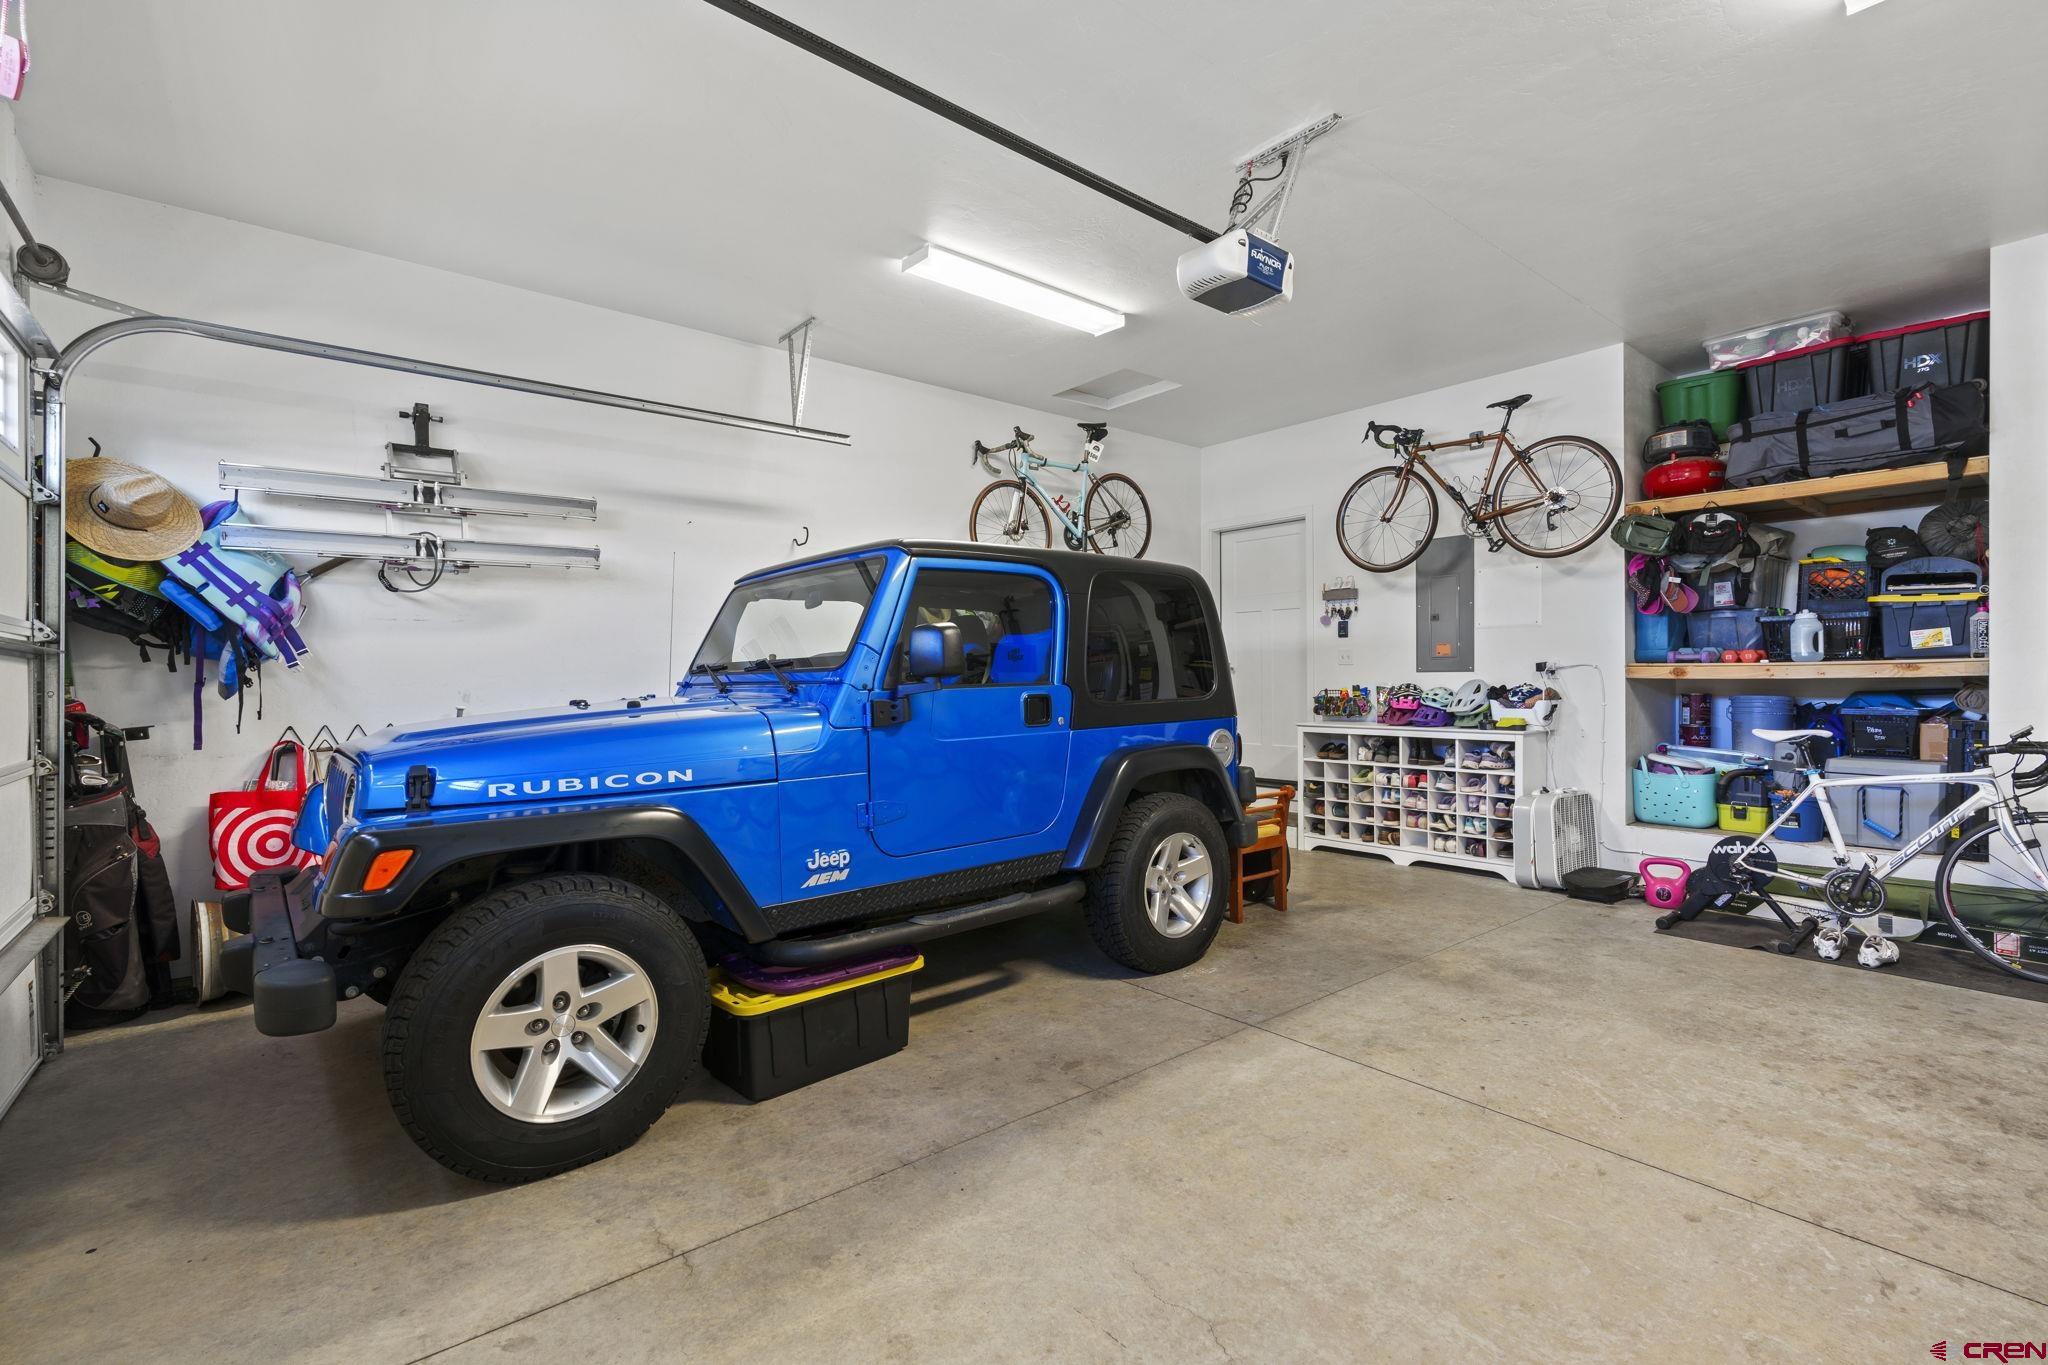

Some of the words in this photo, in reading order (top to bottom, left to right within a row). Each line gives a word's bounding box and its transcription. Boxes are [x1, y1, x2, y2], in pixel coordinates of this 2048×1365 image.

[1251, 249, 1282, 271] RAYNOR
[1903, 352, 1943, 370] HDX
[488, 769, 694, 798] RUBICON
[1888, 808, 1961, 869] SCOTT
[806, 848, 850, 871] Jeep
[800, 868, 849, 889] AEM
